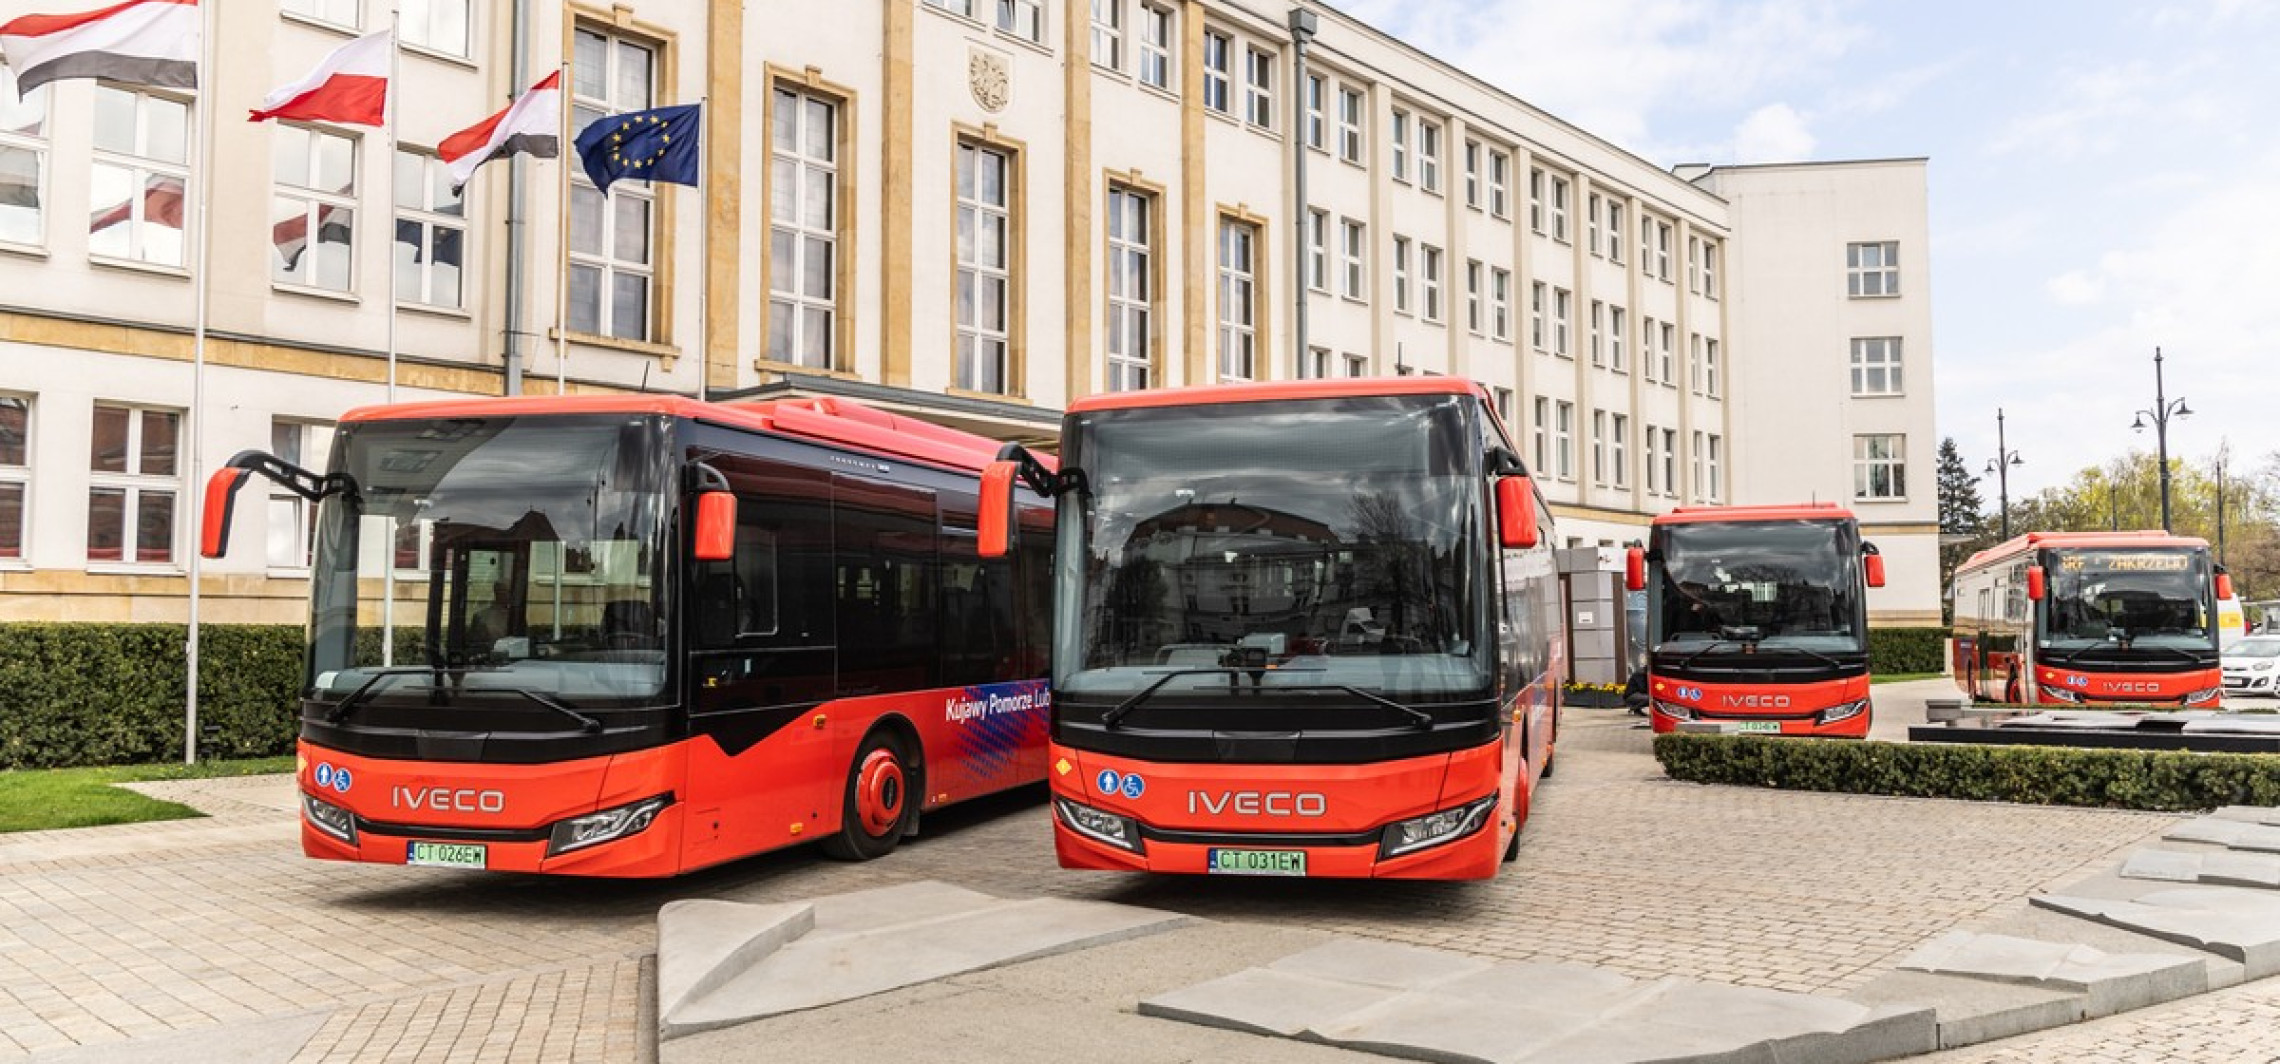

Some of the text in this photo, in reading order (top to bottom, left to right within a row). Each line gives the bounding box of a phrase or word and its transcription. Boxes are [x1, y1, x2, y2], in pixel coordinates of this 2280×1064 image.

[2102, 681, 2159, 693] IVECO
[945, 697, 988, 724] Kujawy
[989, 693, 1032, 715] Pomorze
[1722, 694, 1791, 708] IVECO
[392, 785, 504, 813] IVECO
[1187, 790, 1327, 817] IVECO
[417, 844, 434, 861] CT
[1220, 852, 1241, 869] CT
[1247, 852, 1301, 871] 031EW
